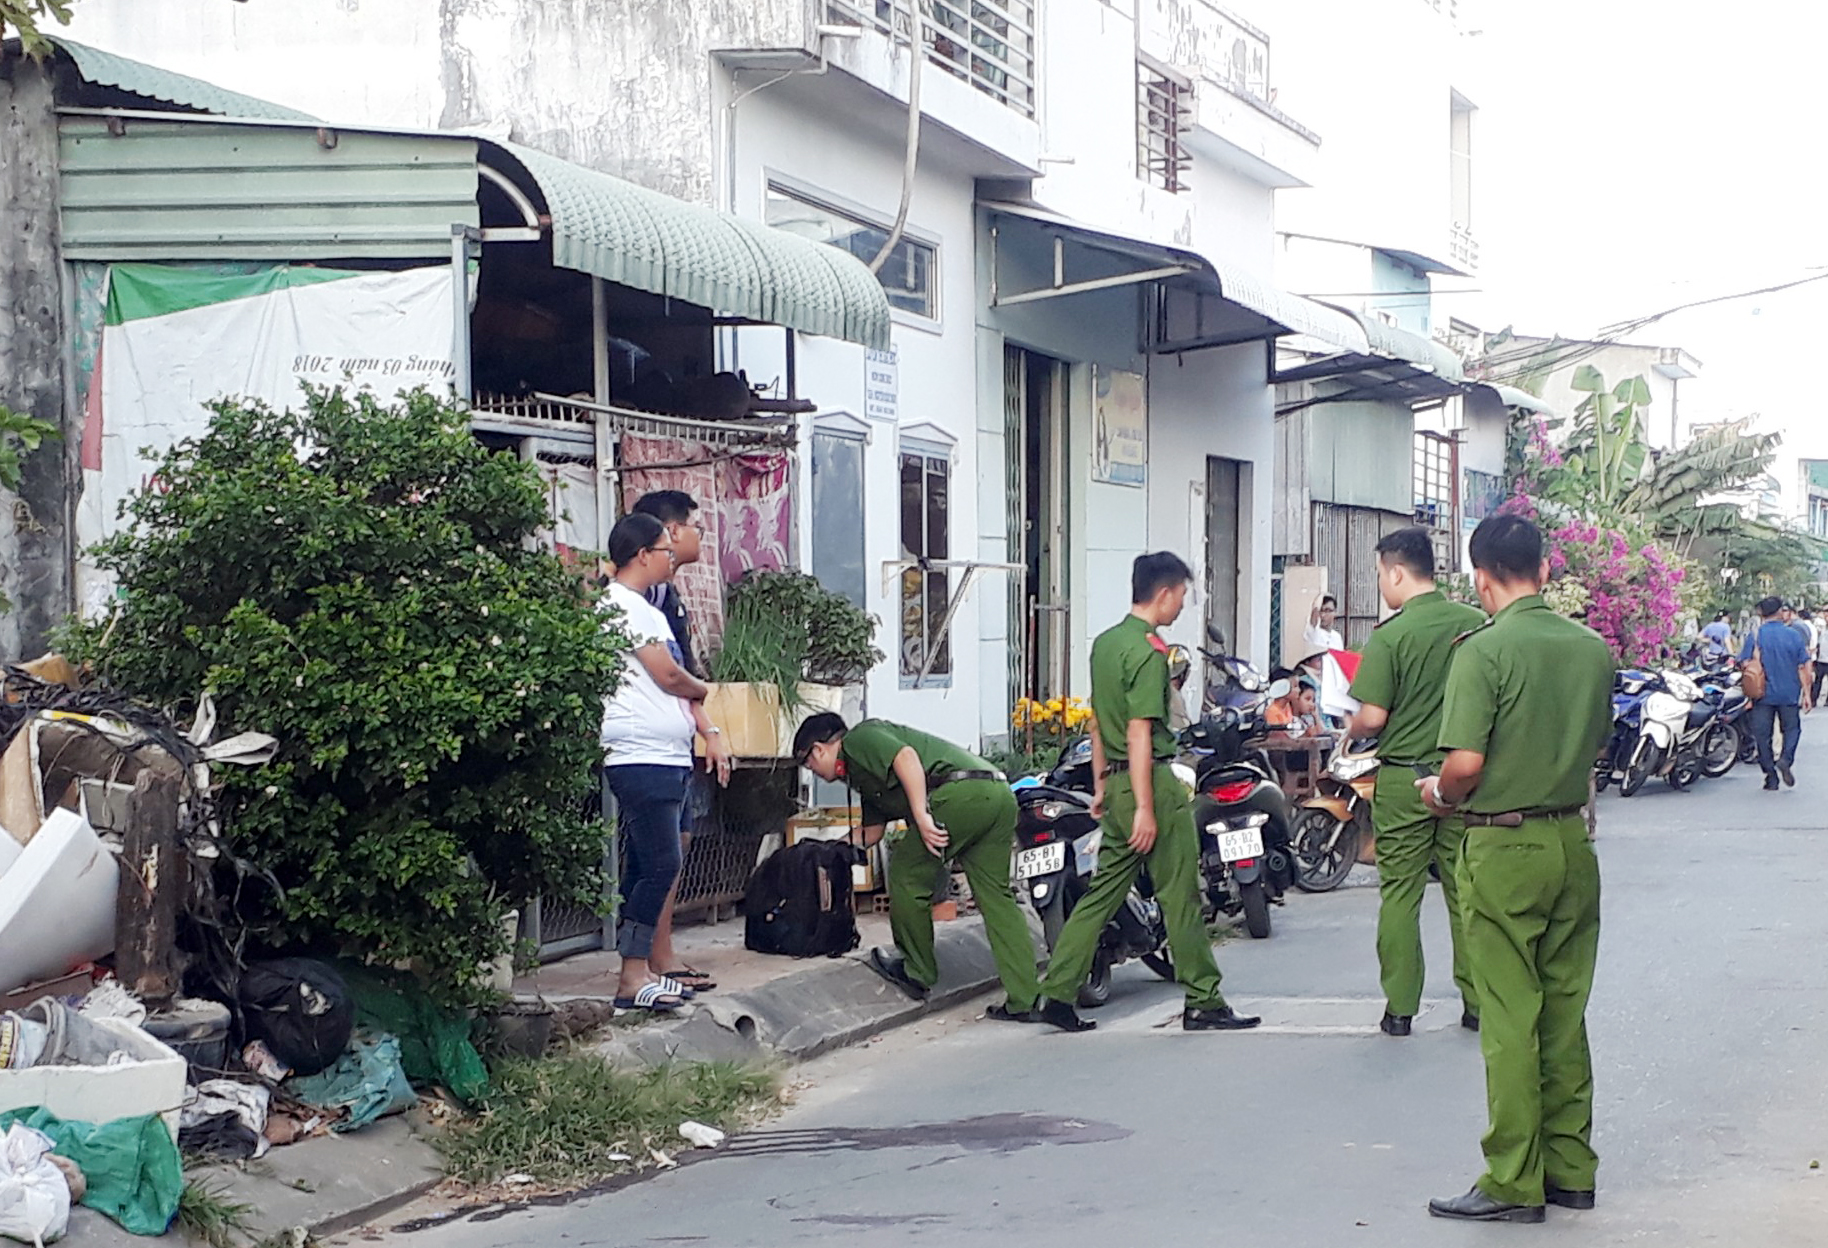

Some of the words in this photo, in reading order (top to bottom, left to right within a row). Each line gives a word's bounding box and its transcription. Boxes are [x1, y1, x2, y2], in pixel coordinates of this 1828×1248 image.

[292, 354, 334, 373] 2018
[339, 358, 380, 374] năm
[382, 359, 402, 376] 03
[1023, 845, 1056, 863] 65-B1
